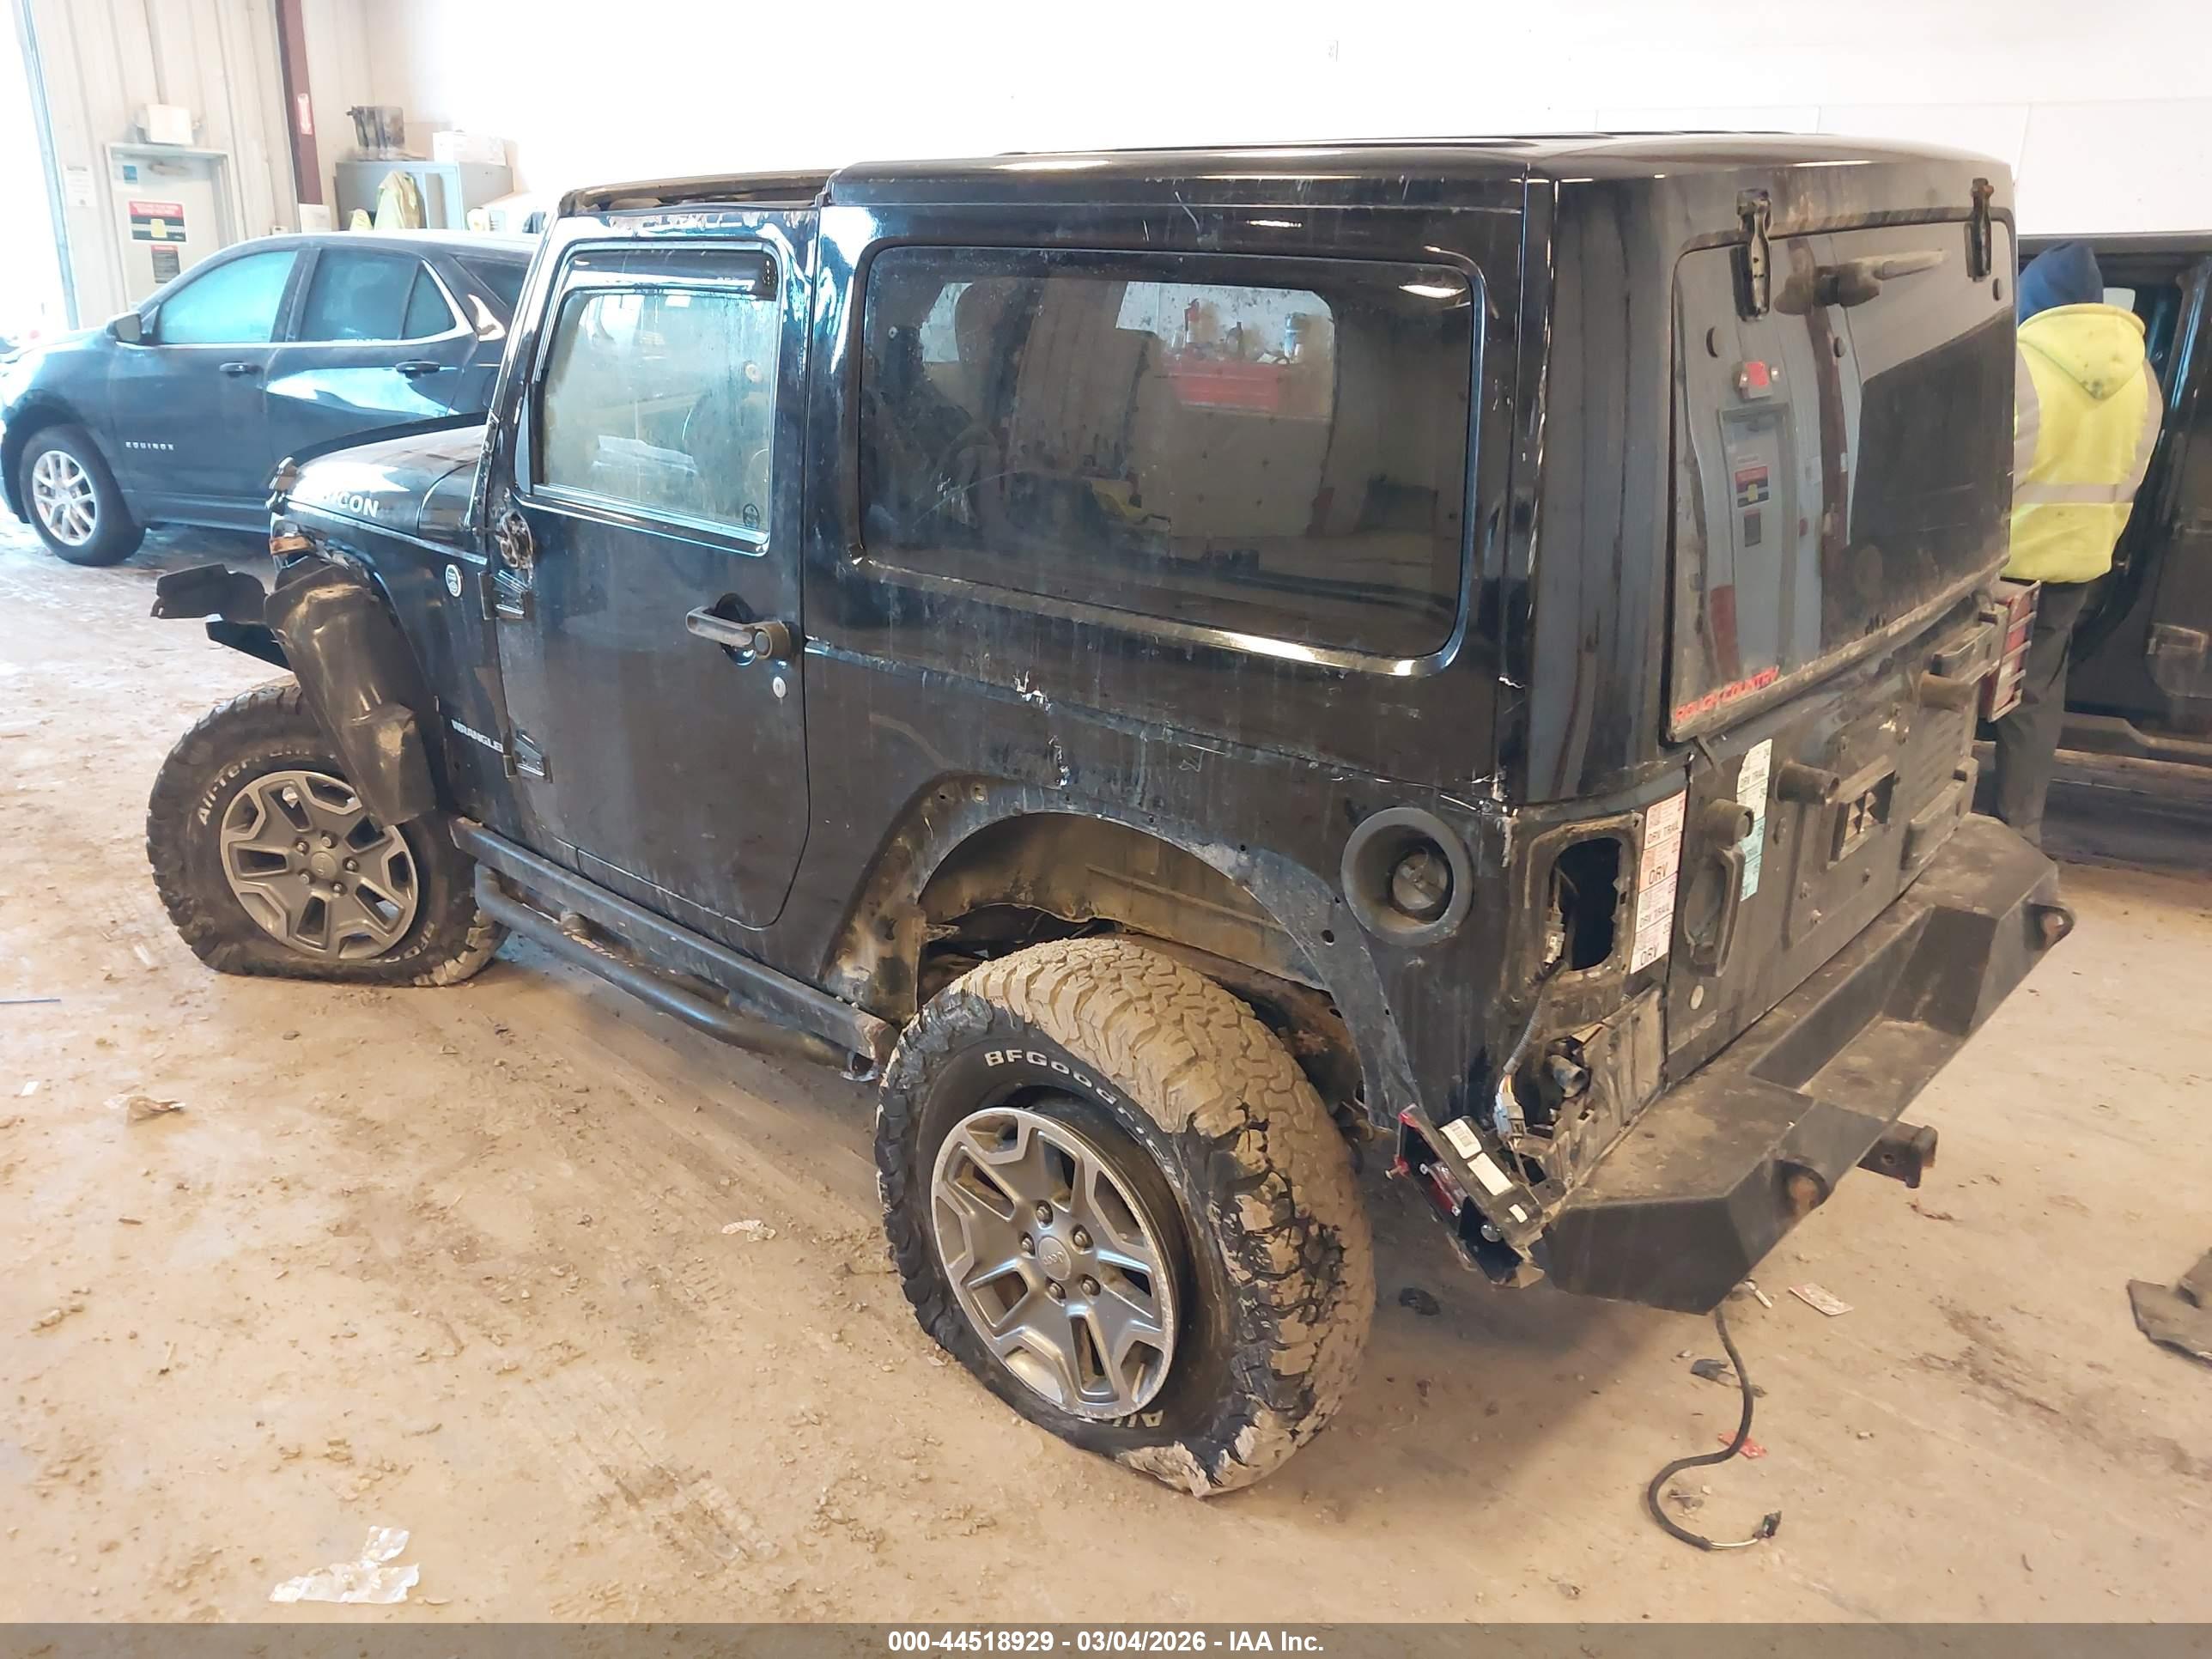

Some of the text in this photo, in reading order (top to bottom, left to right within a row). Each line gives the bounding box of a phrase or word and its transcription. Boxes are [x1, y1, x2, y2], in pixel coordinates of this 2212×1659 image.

[125, 441, 174, 451] EQUINOX
[1649, 860, 1668, 884] ORV
[1641, 941, 1660, 967] ORV
